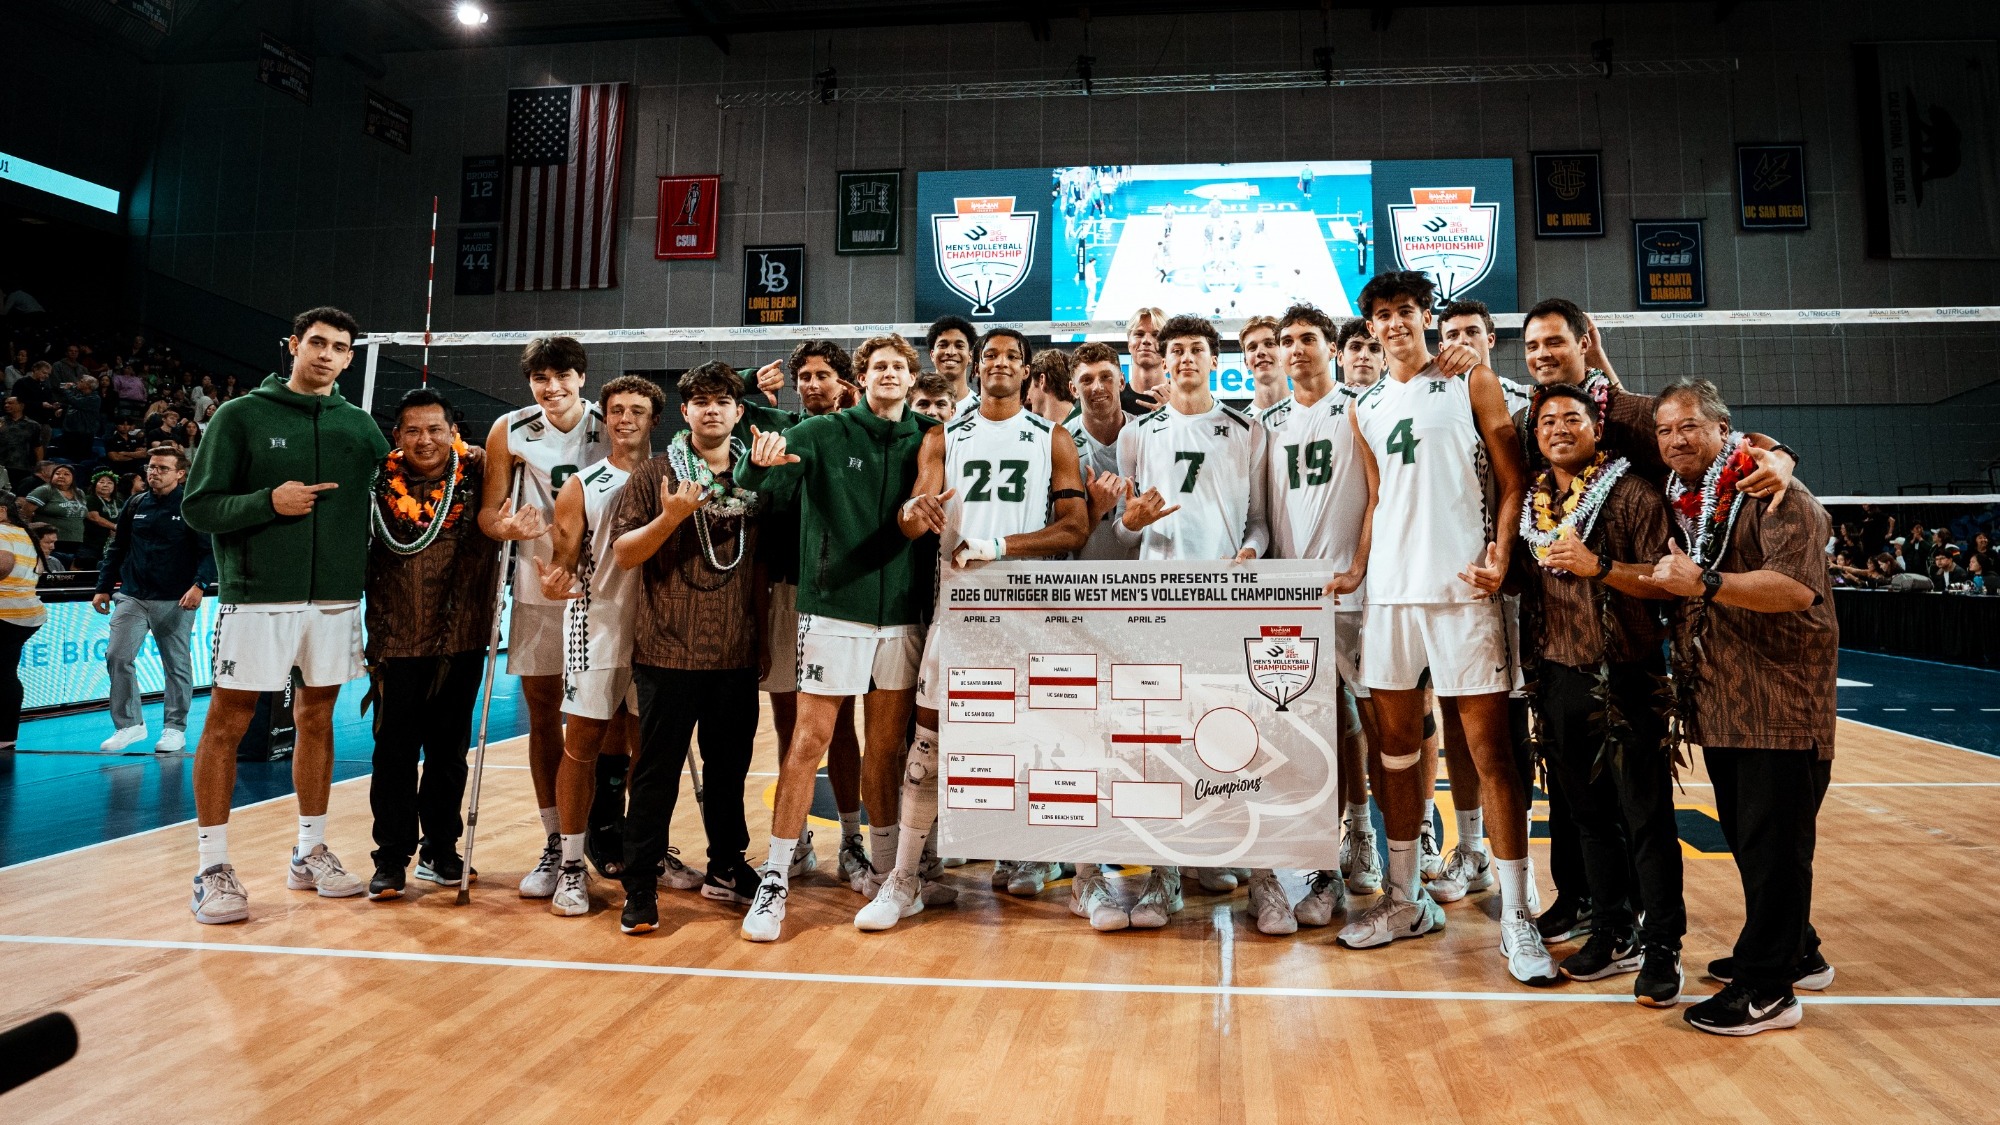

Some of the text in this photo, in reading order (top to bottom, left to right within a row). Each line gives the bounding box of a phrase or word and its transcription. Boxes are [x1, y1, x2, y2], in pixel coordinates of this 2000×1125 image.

[1887, 91, 1907, 205] CALIFORNIA REPUBLIC
[470, 181, 493, 198] 12
[1546, 212, 1592, 226] UC IRVINE
[1744, 205, 1804, 219] UC SAN DIEGO
[675, 234, 697, 247] CSUN
[1405, 242, 1484, 251] CHAMPIONSHIP
[462, 243, 493, 253] MAGEE
[946, 250, 1022, 260] CHAMPIONSHIP
[462, 253, 491, 270] 44
[1647, 252, 1692, 266] UCSB
[1649, 273, 1692, 286] UC SANTA
[1651, 287, 1693, 300] BARBARA
[748, 296, 797, 310] LONG BEACH
[760, 310, 784, 323] STATE
[1386, 417, 1421, 465] 4
[1283, 439, 1333, 490] 19
[1174, 451, 1205, 493] 7
[963, 459, 1030, 502] 23
[1007, 573, 1258, 584] THE HAWAIIAN ISLANDS PRESENTS THE
[950, 587, 1323, 602] 2026 OUTRIGGER BIG WEST MEN'S VOLLEYBALL CHAMPIONSHIP
[963, 616, 1000, 624] APRIL 23
[1044, 616, 1083, 624] APRIL 24
[1127, 616, 1167, 624] APRIL 25
[1194, 776, 1263, 800] Champions
